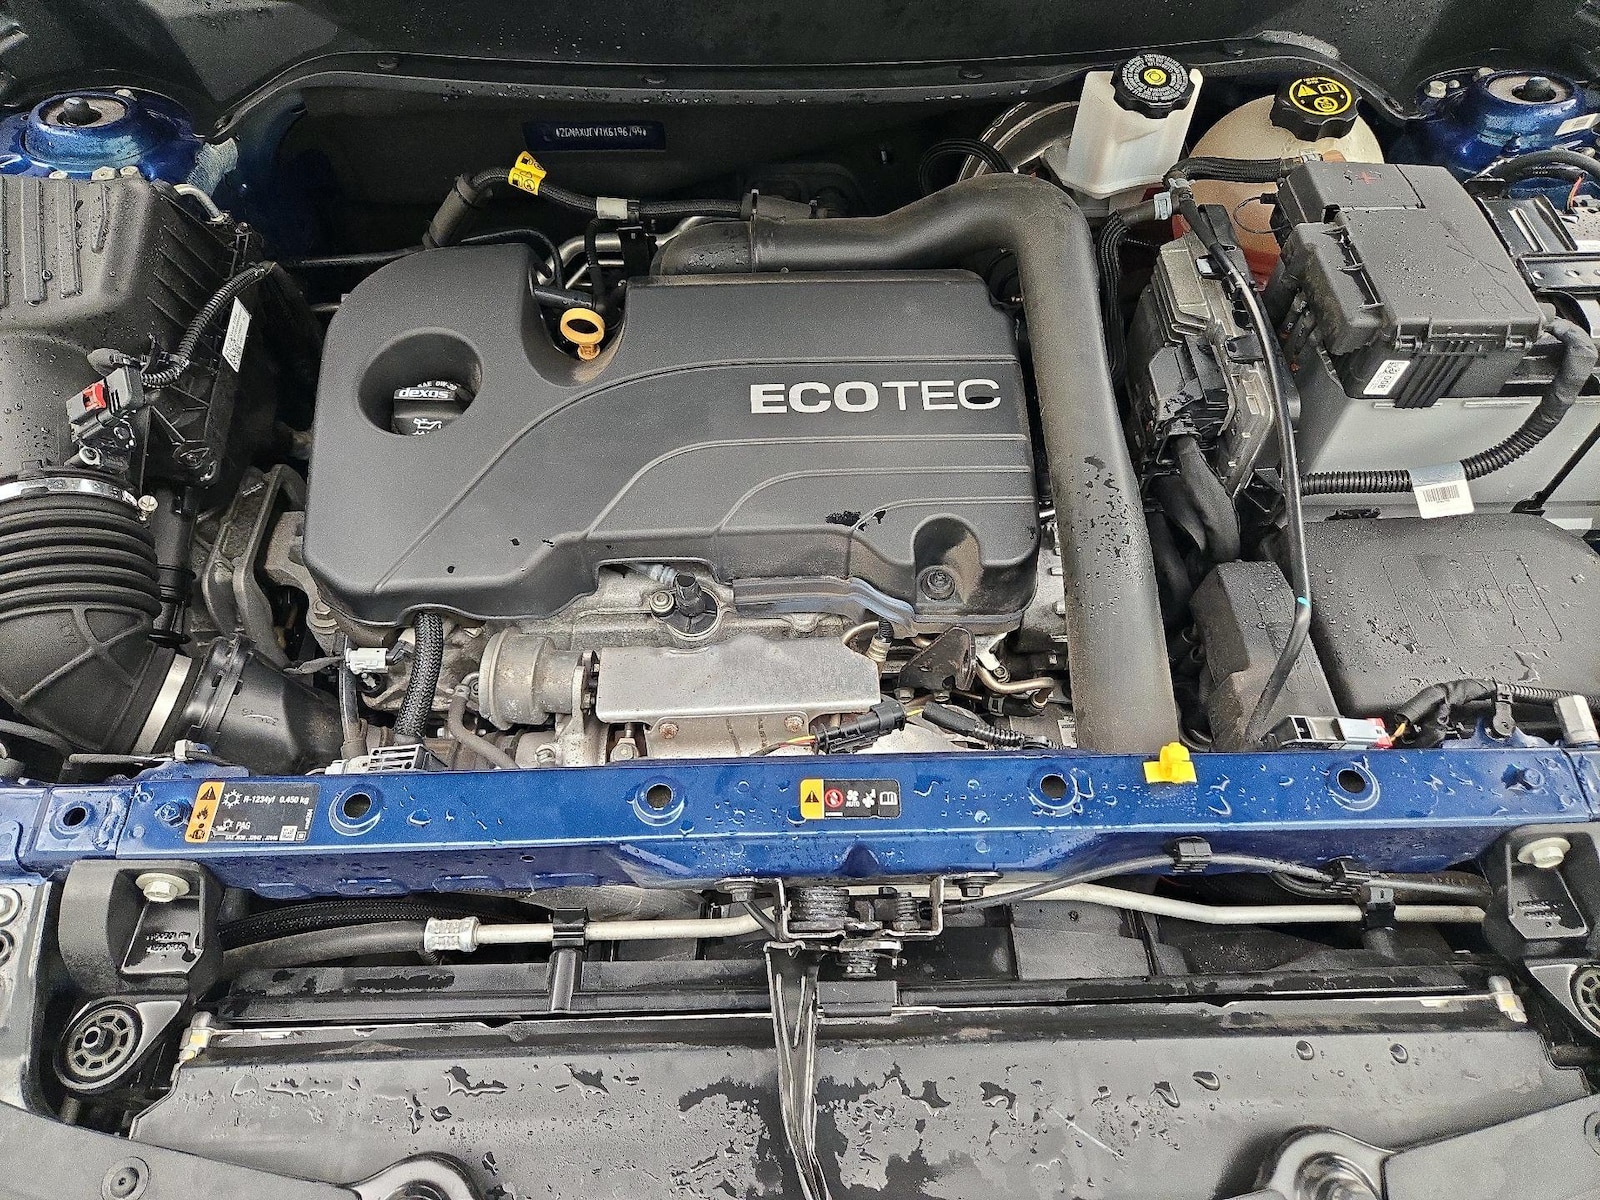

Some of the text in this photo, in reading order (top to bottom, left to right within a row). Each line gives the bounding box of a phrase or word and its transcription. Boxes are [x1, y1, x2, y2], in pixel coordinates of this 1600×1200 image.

[399, 387, 449, 398] dexos
[750, 379, 1001, 414] ECOTEC
[243, 796, 310, 805] R-1234yf 0.450 kg
[235, 821, 252, 830] PAG
